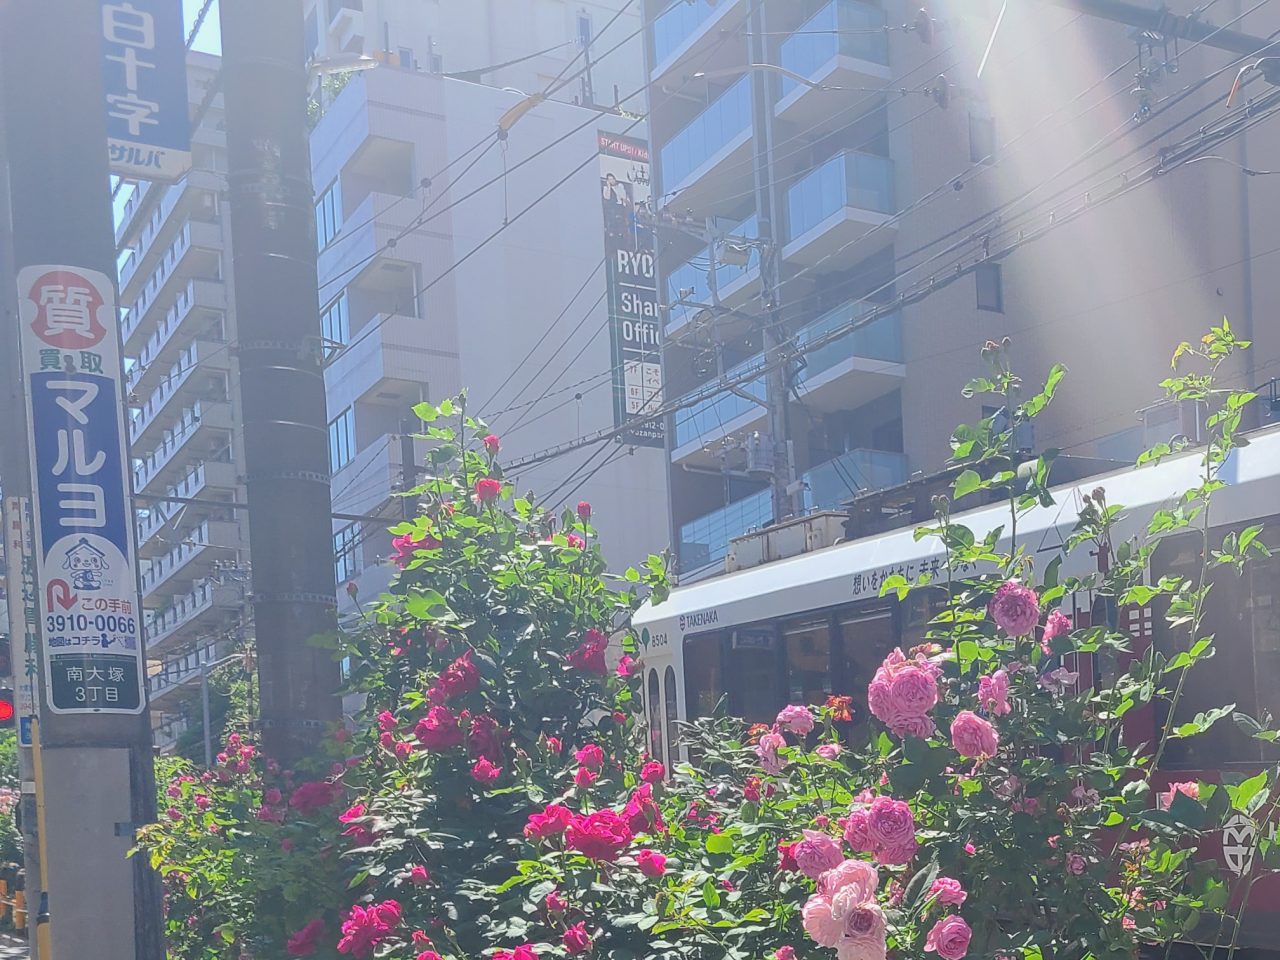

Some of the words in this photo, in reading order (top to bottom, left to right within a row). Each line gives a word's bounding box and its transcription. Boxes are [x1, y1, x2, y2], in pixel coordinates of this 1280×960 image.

[102, 3, 160, 136] 白十字
[39, 284, 95, 339] 質
[39, 349, 104, 374] 買取
[45, 380, 107, 529] マルヨ
[81, 597, 132, 615] この手前
[46, 614, 136, 634] 3910-0066
[686, 609, 719, 628] TAKENAKA
[652, 633, 668, 648] 8504
[66, 665, 126, 682] 南大塚
[75, 686, 119, 702] 3丁目
